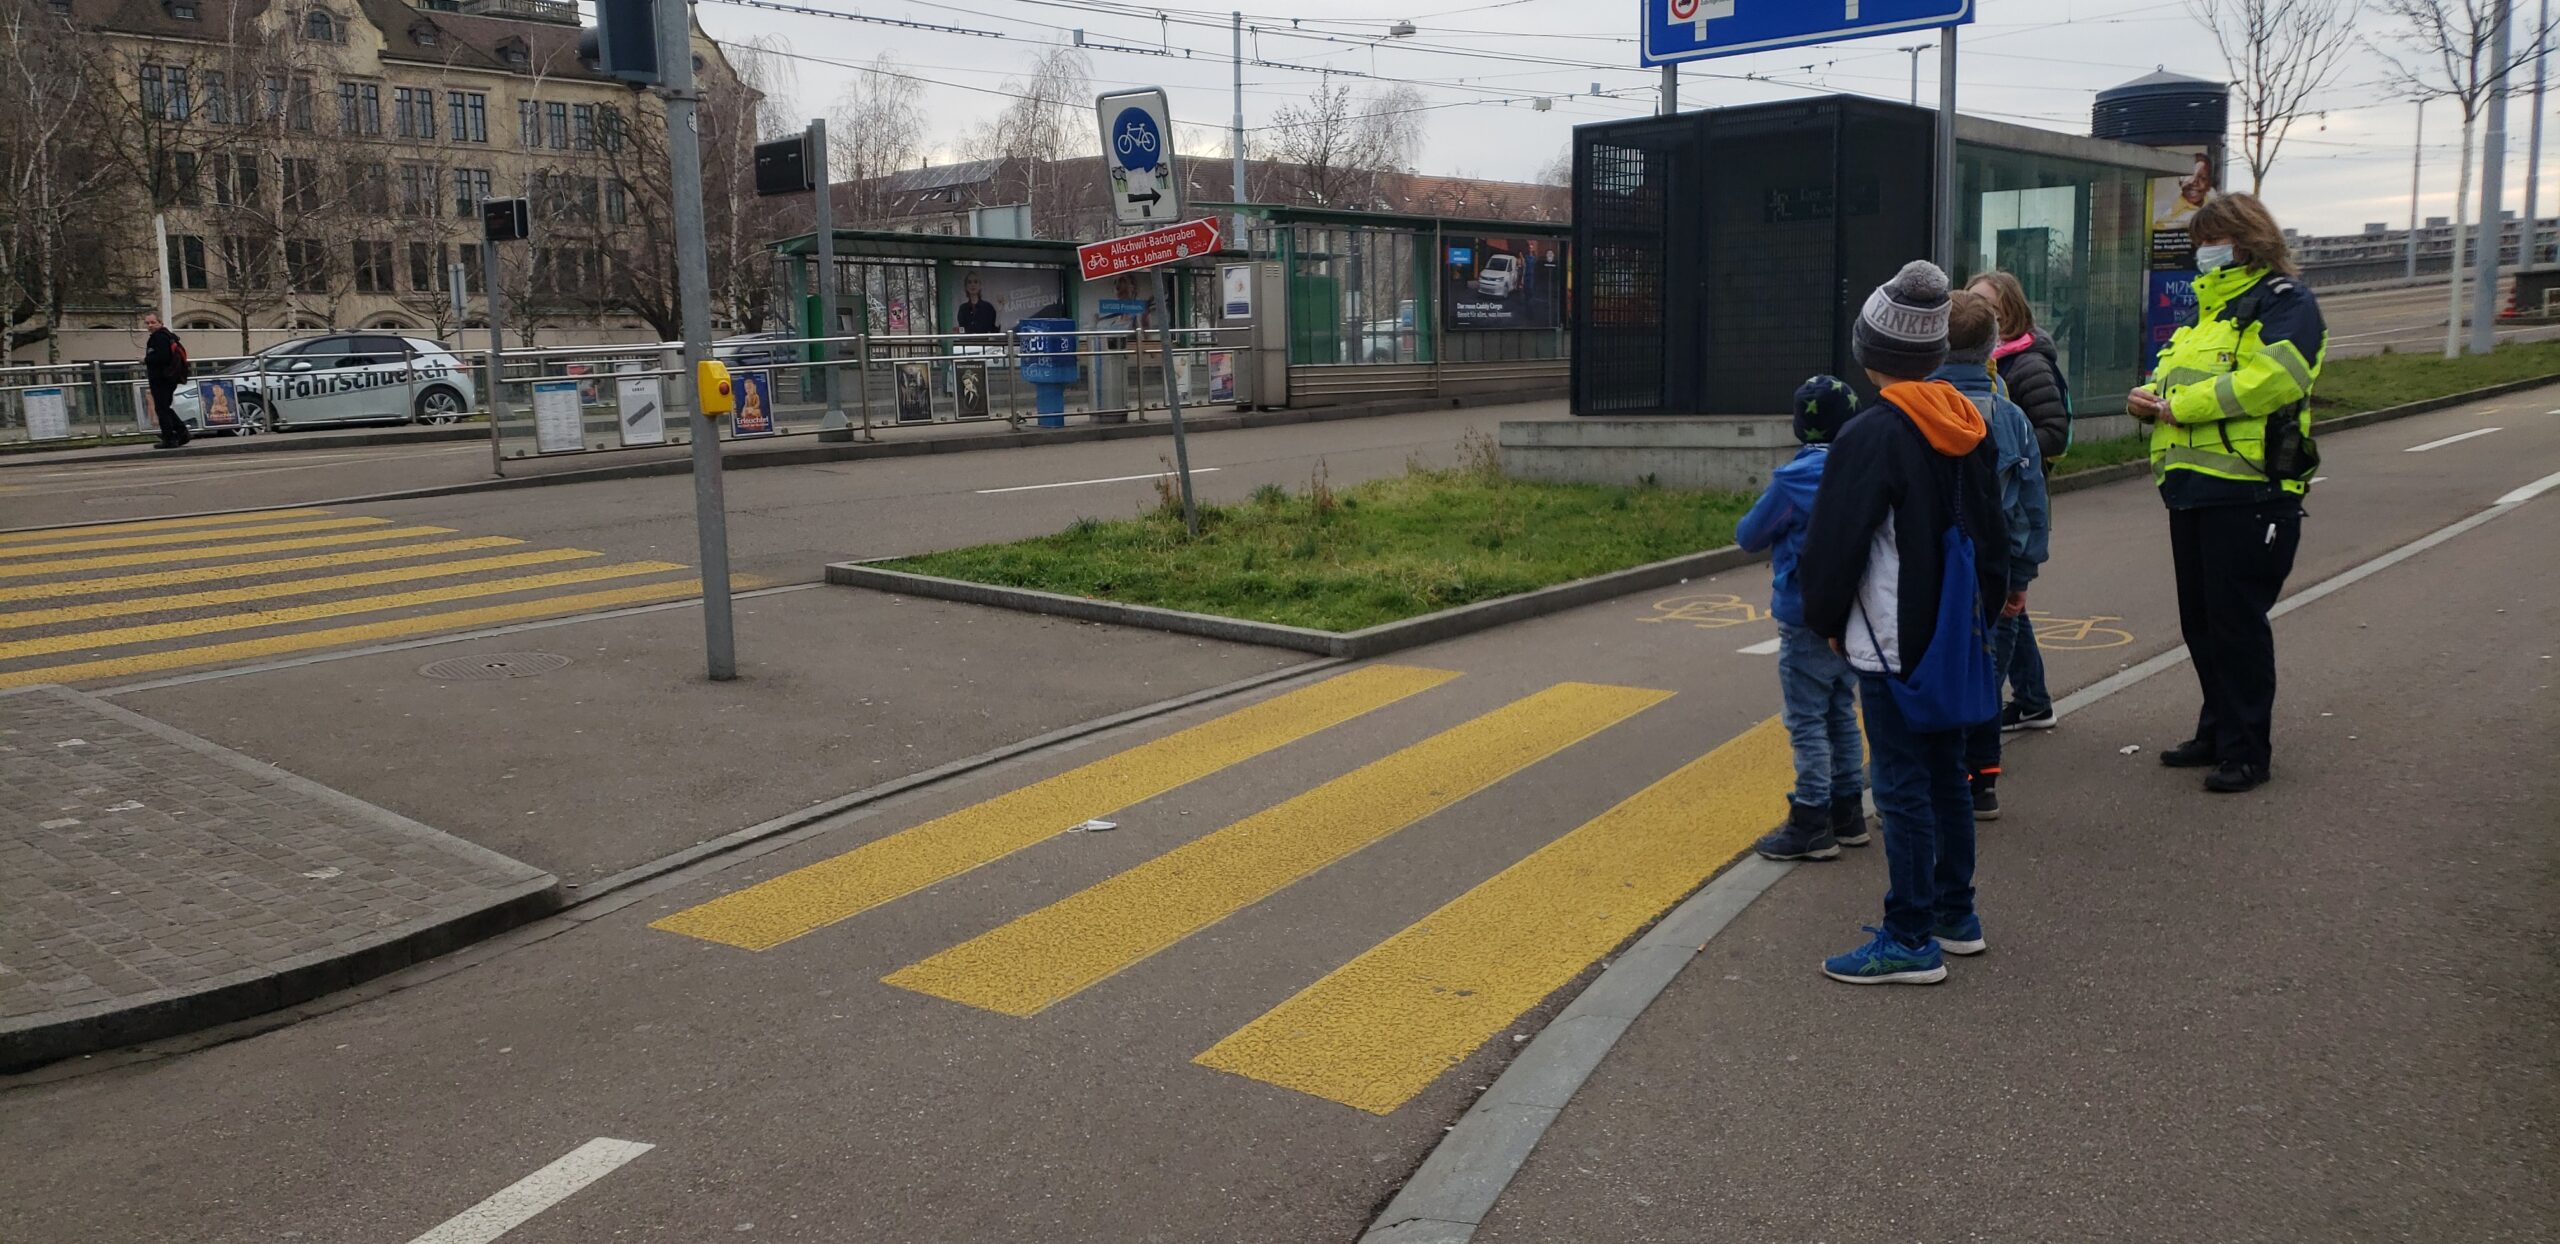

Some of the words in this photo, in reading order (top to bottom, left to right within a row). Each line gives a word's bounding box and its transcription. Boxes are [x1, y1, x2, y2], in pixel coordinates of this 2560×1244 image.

[1111, 229, 1196, 256] Allschwil-Bachgraben
[1113, 258, 1129, 269] Bhf.
[1131, 256, 1142, 266] St.
[1144, 249, 1172, 263] Johann
[1871, 300, 1946, 335] YANKEES
